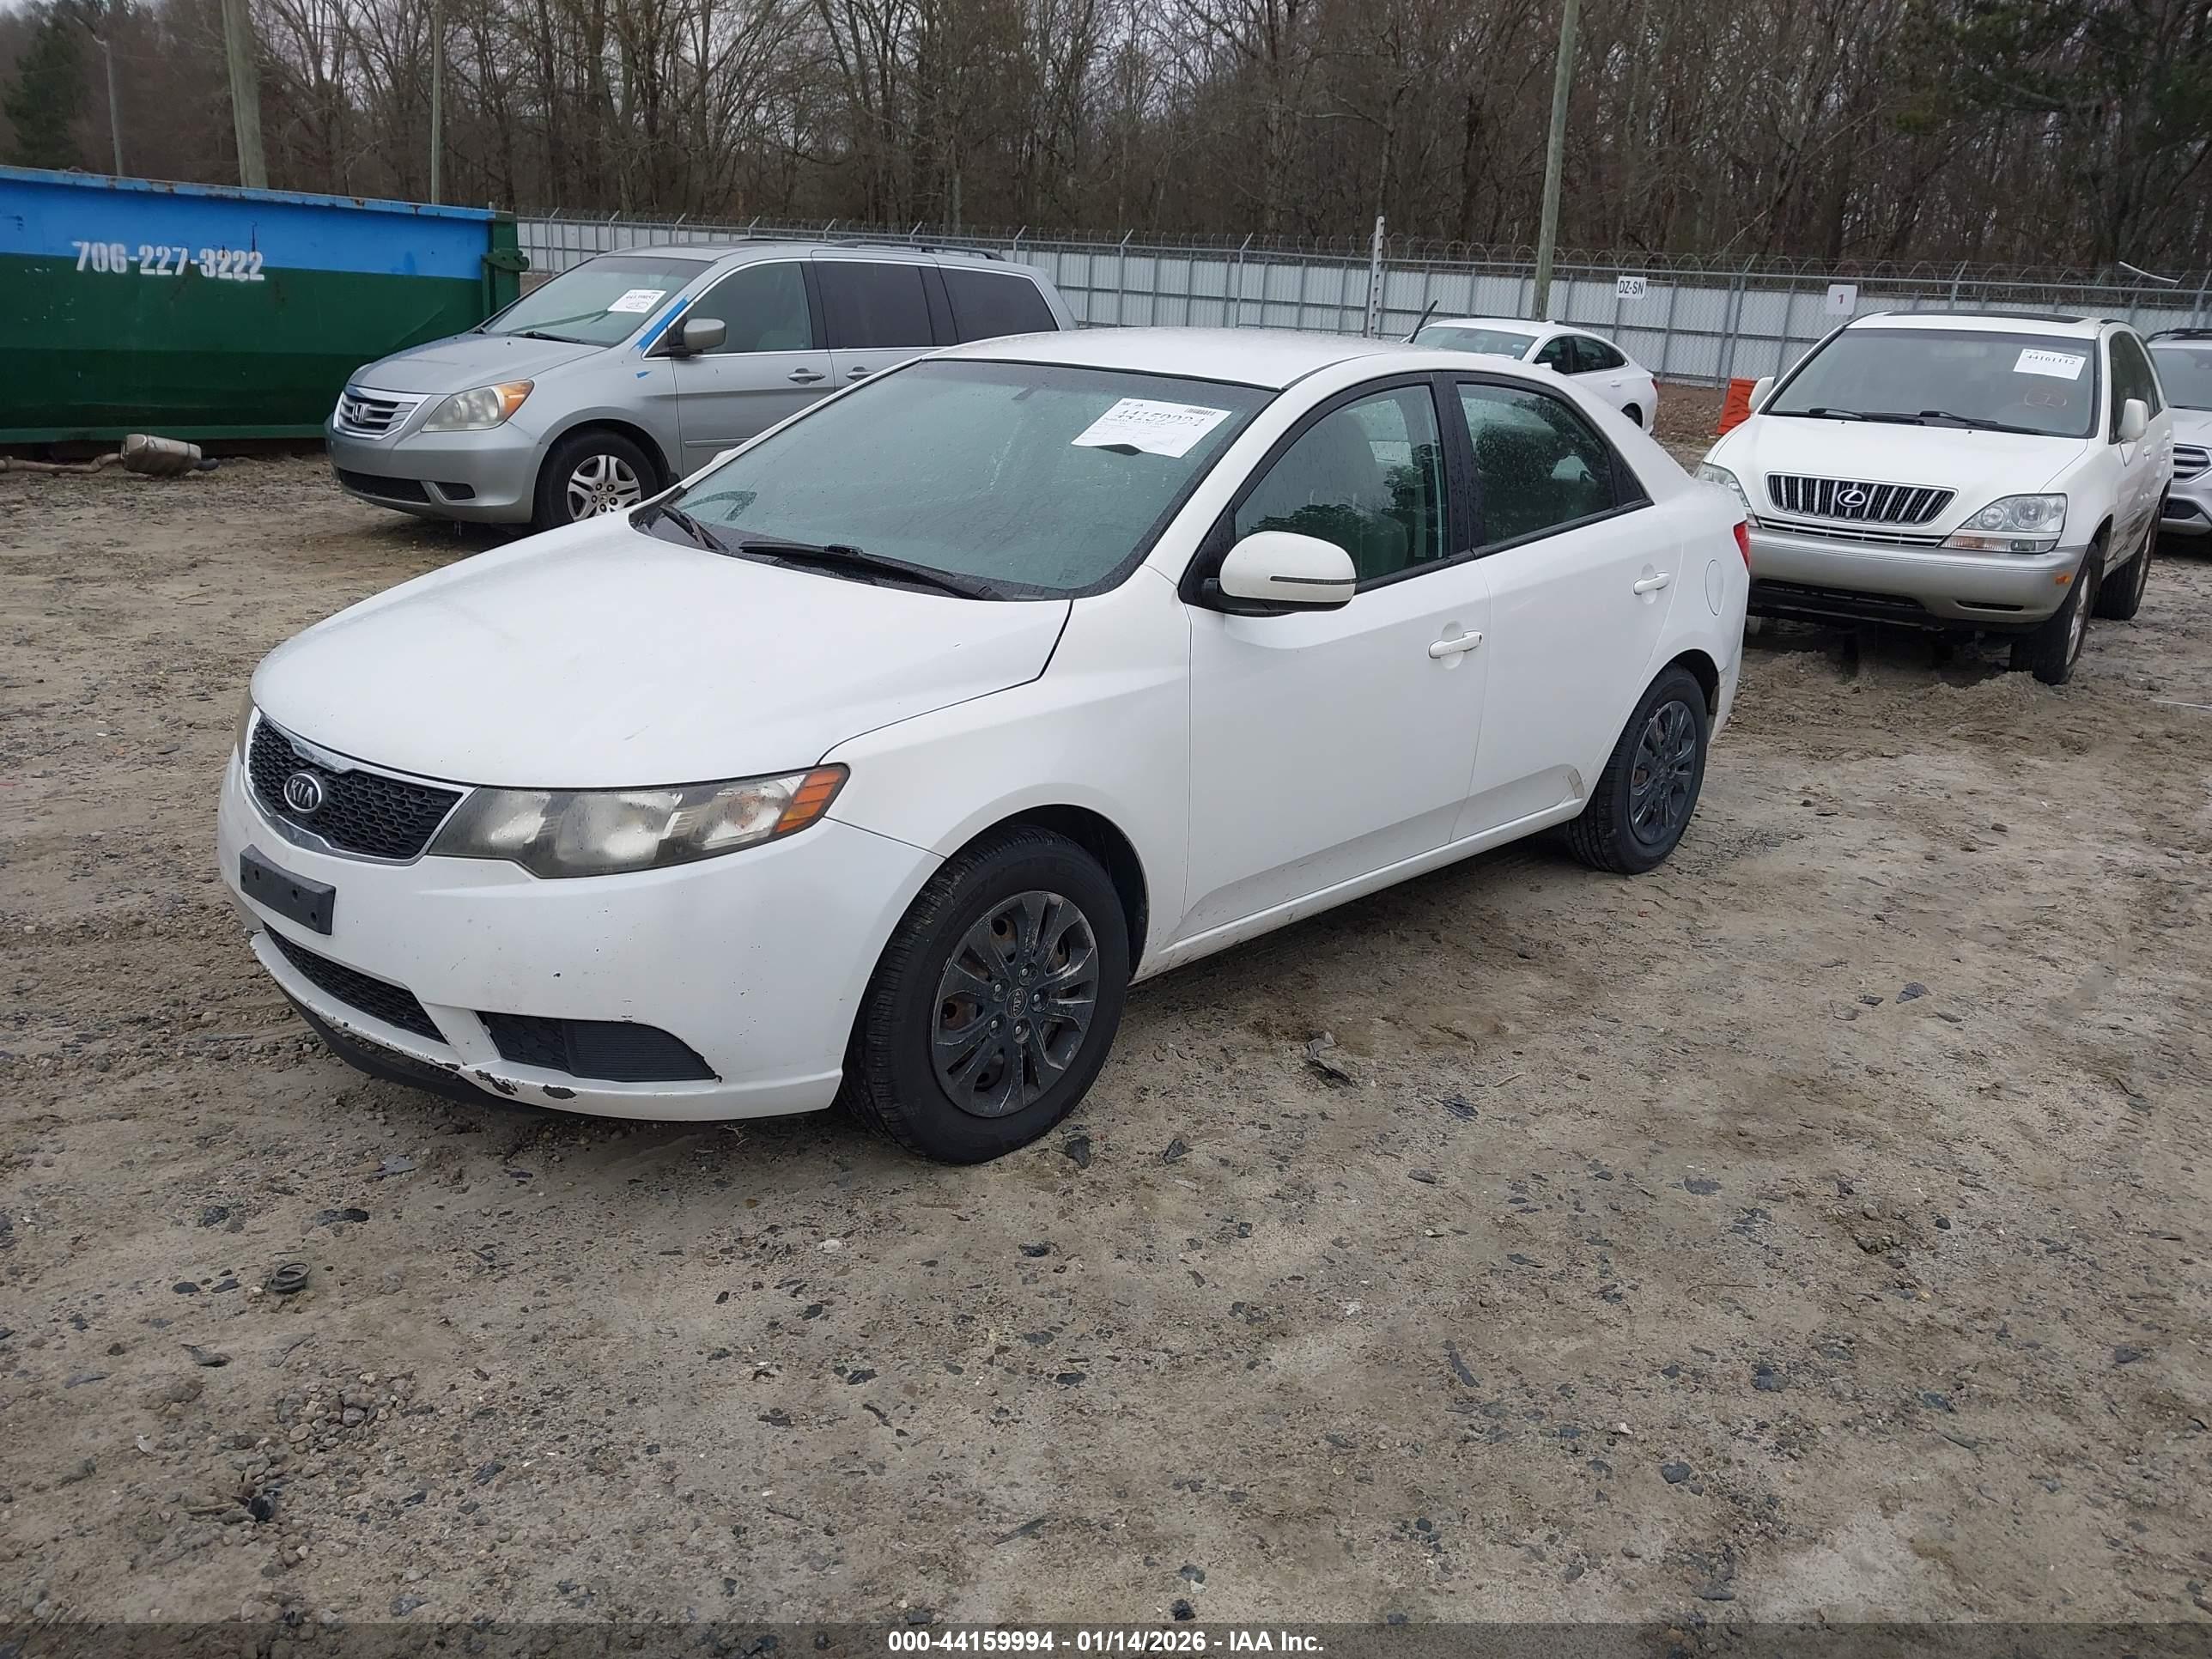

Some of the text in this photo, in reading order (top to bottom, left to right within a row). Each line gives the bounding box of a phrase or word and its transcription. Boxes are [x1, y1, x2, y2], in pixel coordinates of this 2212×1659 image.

[71, 241, 264, 281] 706-227-3222
[1619, 280, 1644, 295] DZ-SN
[1838, 294, 1844, 305] 1
[289, 779, 313, 807] KIA
